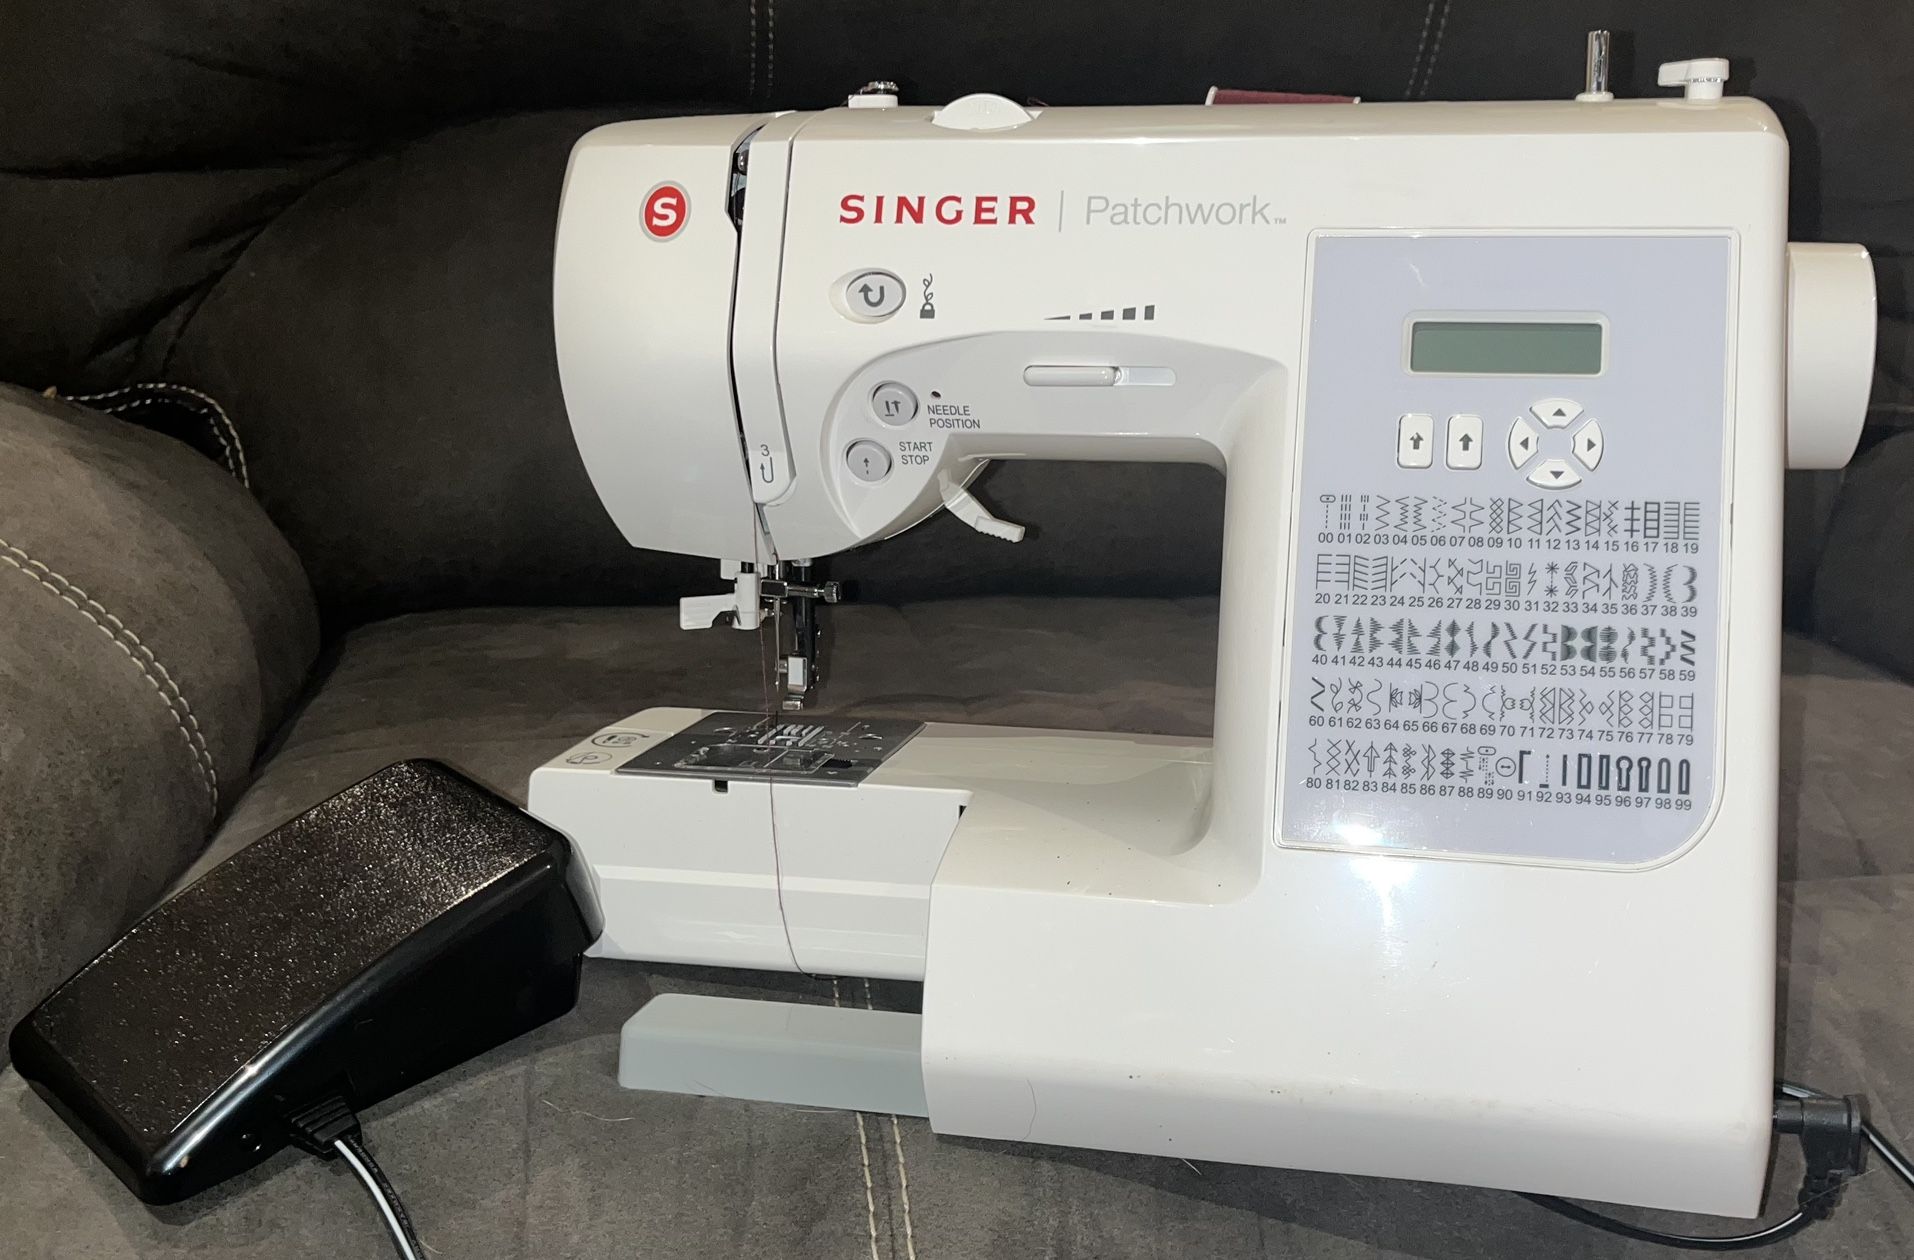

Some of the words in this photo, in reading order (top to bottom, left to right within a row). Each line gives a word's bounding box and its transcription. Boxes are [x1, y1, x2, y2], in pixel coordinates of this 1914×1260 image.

[652, 196, 678, 227] S
[840, 194, 1036, 225] SINGER
[927, 404, 971, 416] NEEDLE
[929, 417, 981, 429] POSITION
[760, 444, 770, 457] 3
[898, 441, 933, 452] START
[901, 455, 930, 466] STOP
[1318, 532, 1334, 543] 00
[1338, 533, 1351, 544] 01
[1355, 533, 1370, 544] 02
[1374, 534, 1389, 545] 03
[1392, 534, 1408, 545] 04
[1411, 535, 1427, 546] 05
[1430, 535, 1446, 547] 06
[1449, 536, 1465, 547] 07
[1468, 536, 1484, 548] 08
[1487, 537, 1503, 548] 09
[1507, 538, 1522, 549] 10
[1528, 538, 1540, 549] 11
[1546, 539, 1561, 550] 12
[1566, 539, 1580, 550] 13
[1585, 540, 1599, 550] 14
[1605, 540, 1619, 552] 15
[1624, 541, 1639, 552] 16
[1645, 542, 1659, 552] 17
[1664, 542, 1678, 553] 18
[1683, 543, 1699, 554] 19
[1315, 593, 1330, 604] 20
[1335, 594, 1348, 604] 21
[1352, 594, 1367, 605] 22
[1371, 595, 1386, 606] 23
[1390, 595, 1405, 606] 24
[1409, 596, 1424, 607] 25
[1427, 597, 1443, 608] 26
[1447, 597, 1463, 608] 27
[1466, 598, 1481, 609] 28
[1485, 599, 1501, 610] 29
[1504, 600, 1520, 611] 30
[1524, 600, 1539, 611] 31
[1543, 601, 1559, 612] 32
[1563, 601, 1578, 613] 33
[1582, 602, 1598, 613] 34
[1601, 603, 1618, 614] 35
[1621, 604, 1637, 615] 36
[1641, 604, 1657, 616] 37
[1661, 605, 1677, 616] 38
[1681, 606, 1697, 617] 39
[1312, 654, 1327, 665] 40
[1331, 655, 1345, 666] 41
[1349, 656, 1365, 667] 42
[1368, 656, 1383, 668] 43
[1387, 657, 1402, 668] 44
[1406, 658, 1422, 669] 45
[1425, 659, 1441, 670] 46
[1444, 660, 1460, 671] 47
[1463, 661, 1479, 672] 48
[1482, 661, 1498, 672] 49
[1502, 662, 1517, 673] 50
[1522, 663, 1536, 674] 51
[1540, 664, 1557, 675] 52
[1560, 665, 1576, 676] 53
[1580, 665, 1595, 677] 54
[1600, 666, 1616, 678] 55
[1619, 667, 1635, 679] 56
[1639, 668, 1656, 679] 57
[1659, 669, 1675, 680] 58
[1679, 670, 1695, 681] 59
[1309, 715, 1324, 727] 60
[1328, 716, 1342, 727] 61
[1346, 717, 1362, 728] 62
[1365, 718, 1380, 730] 63
[1384, 719, 1399, 730] 64
[1403, 720, 1419, 732] 65
[1422, 721, 1438, 733] 66
[1442, 722, 1457, 733] 67
[1460, 723, 1476, 734] 68
[1480, 724, 1496, 736] 69
[1500, 725, 1515, 736] 70
[1520, 726, 1534, 737] 71
[1538, 727, 1554, 739] 72
[1558, 728, 1574, 740] 73
[1577, 729, 1593, 741] 74
[1598, 730, 1614, 742] 75
[1617, 731, 1633, 743] 76
[1637, 732, 1653, 743] 77
[1657, 733, 1673, 745] 78
[1677, 734, 1693, 746] 79
[1306, 777, 1321, 789] 80
[1326, 778, 1340, 790] 81
[1343, 779, 1359, 792] 82
[1362, 780, 1378, 792] 83
[1381, 782, 1397, 793] 84
[1400, 782, 1416, 794] 85
[1420, 784, 1435, 796] 86
[1439, 785, 1455, 796] 87
[1458, 786, 1474, 798] 88
[1477, 787, 1493, 799] 89
[1497, 789, 1513, 800] 90
[1517, 790, 1532, 801] 91
[1536, 791, 1552, 803] 92
[1556, 792, 1572, 804] 93
[1575, 793, 1591, 804] 94
[1595, 794, 1612, 806] 95
[1615, 795, 1631, 807] 96
[1635, 796, 1651, 808] 97
[1655, 798, 1671, 809] 98
[1675, 799, 1691, 811] 99
